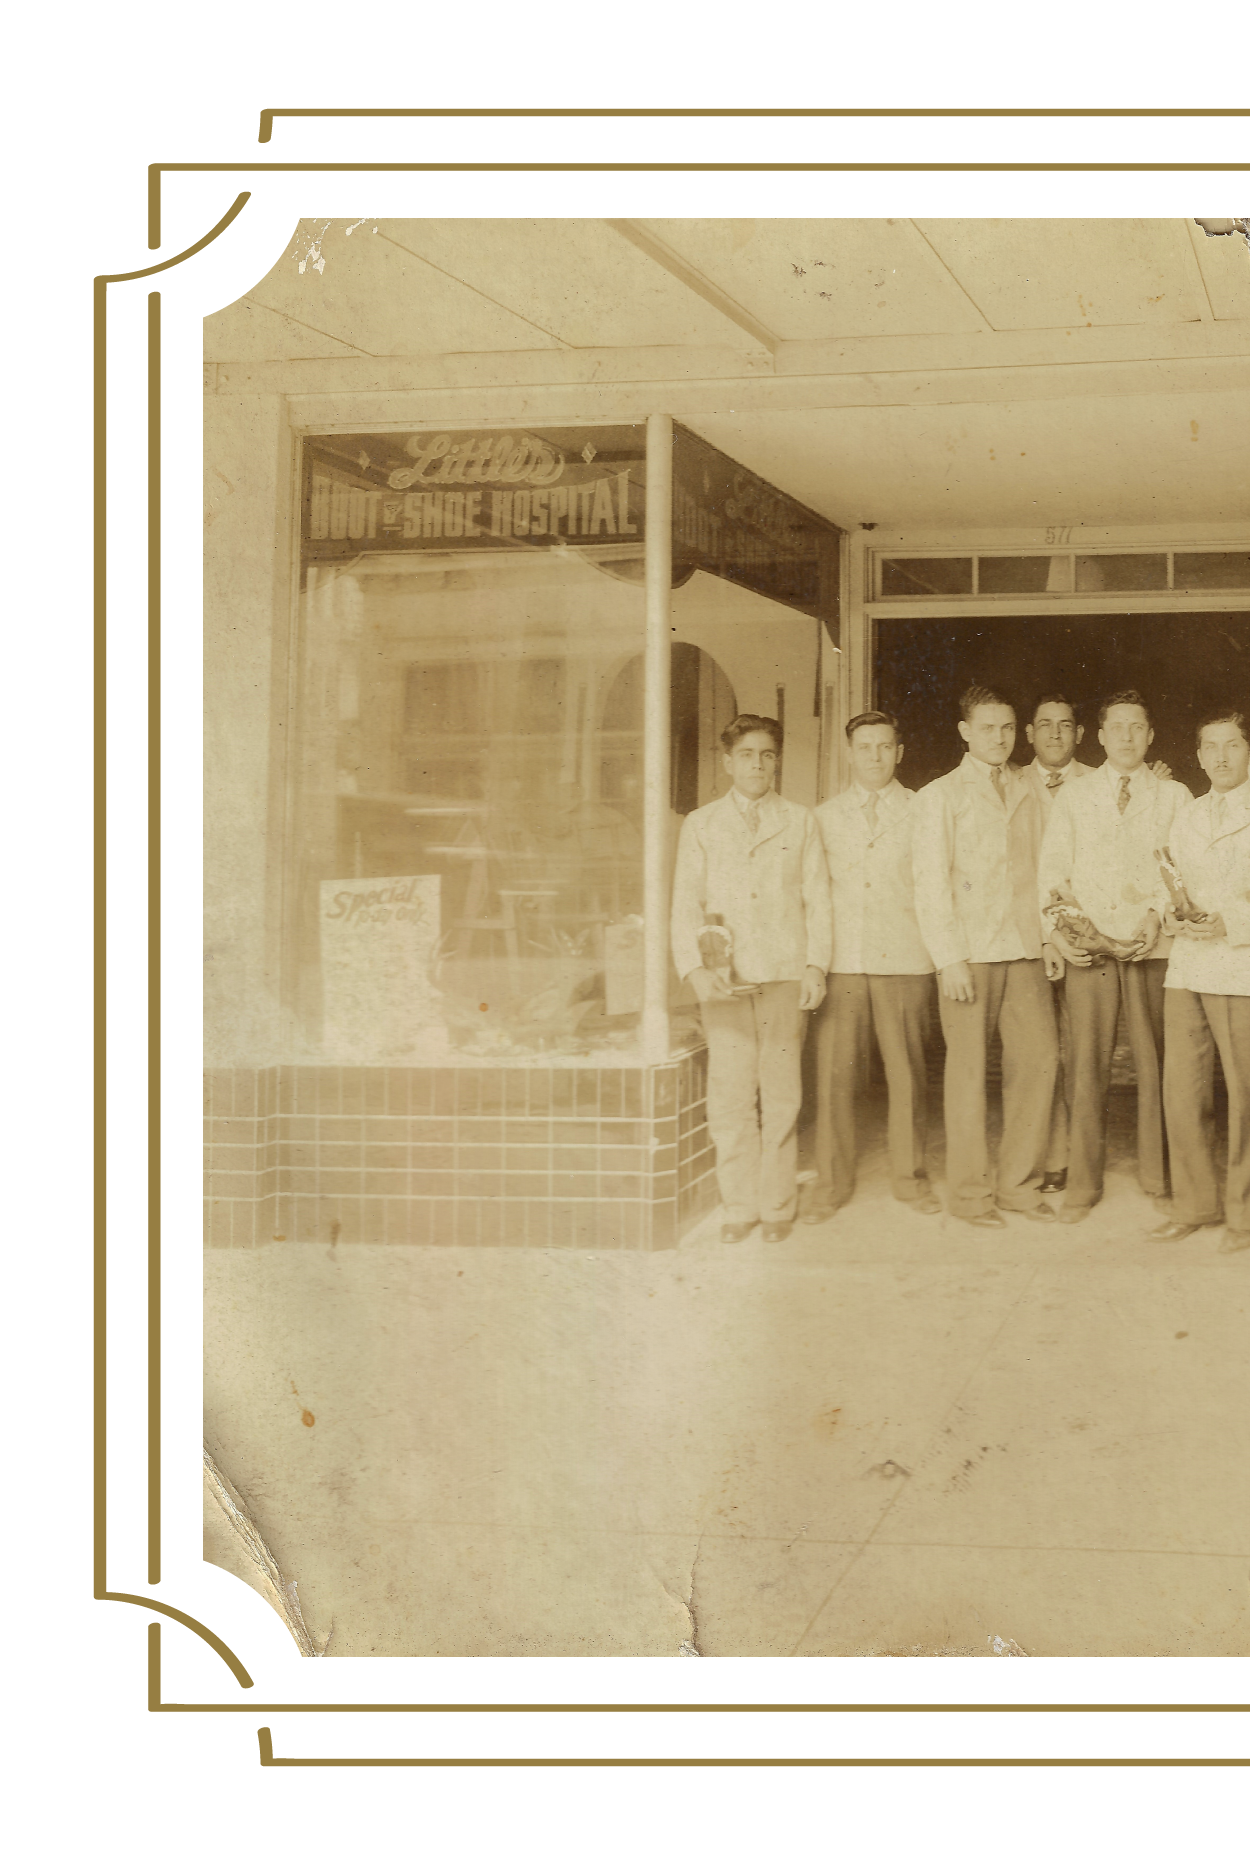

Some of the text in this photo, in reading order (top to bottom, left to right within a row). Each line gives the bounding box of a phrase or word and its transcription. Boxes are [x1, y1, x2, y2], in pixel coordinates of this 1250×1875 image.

[388, 434, 565, 489] Little's
[310, 475, 383, 539] BOOT
[403, 490, 482, 539] SHOE
[491, 468, 636, 537] HOSPITAL
[325, 878, 423, 923] Special
